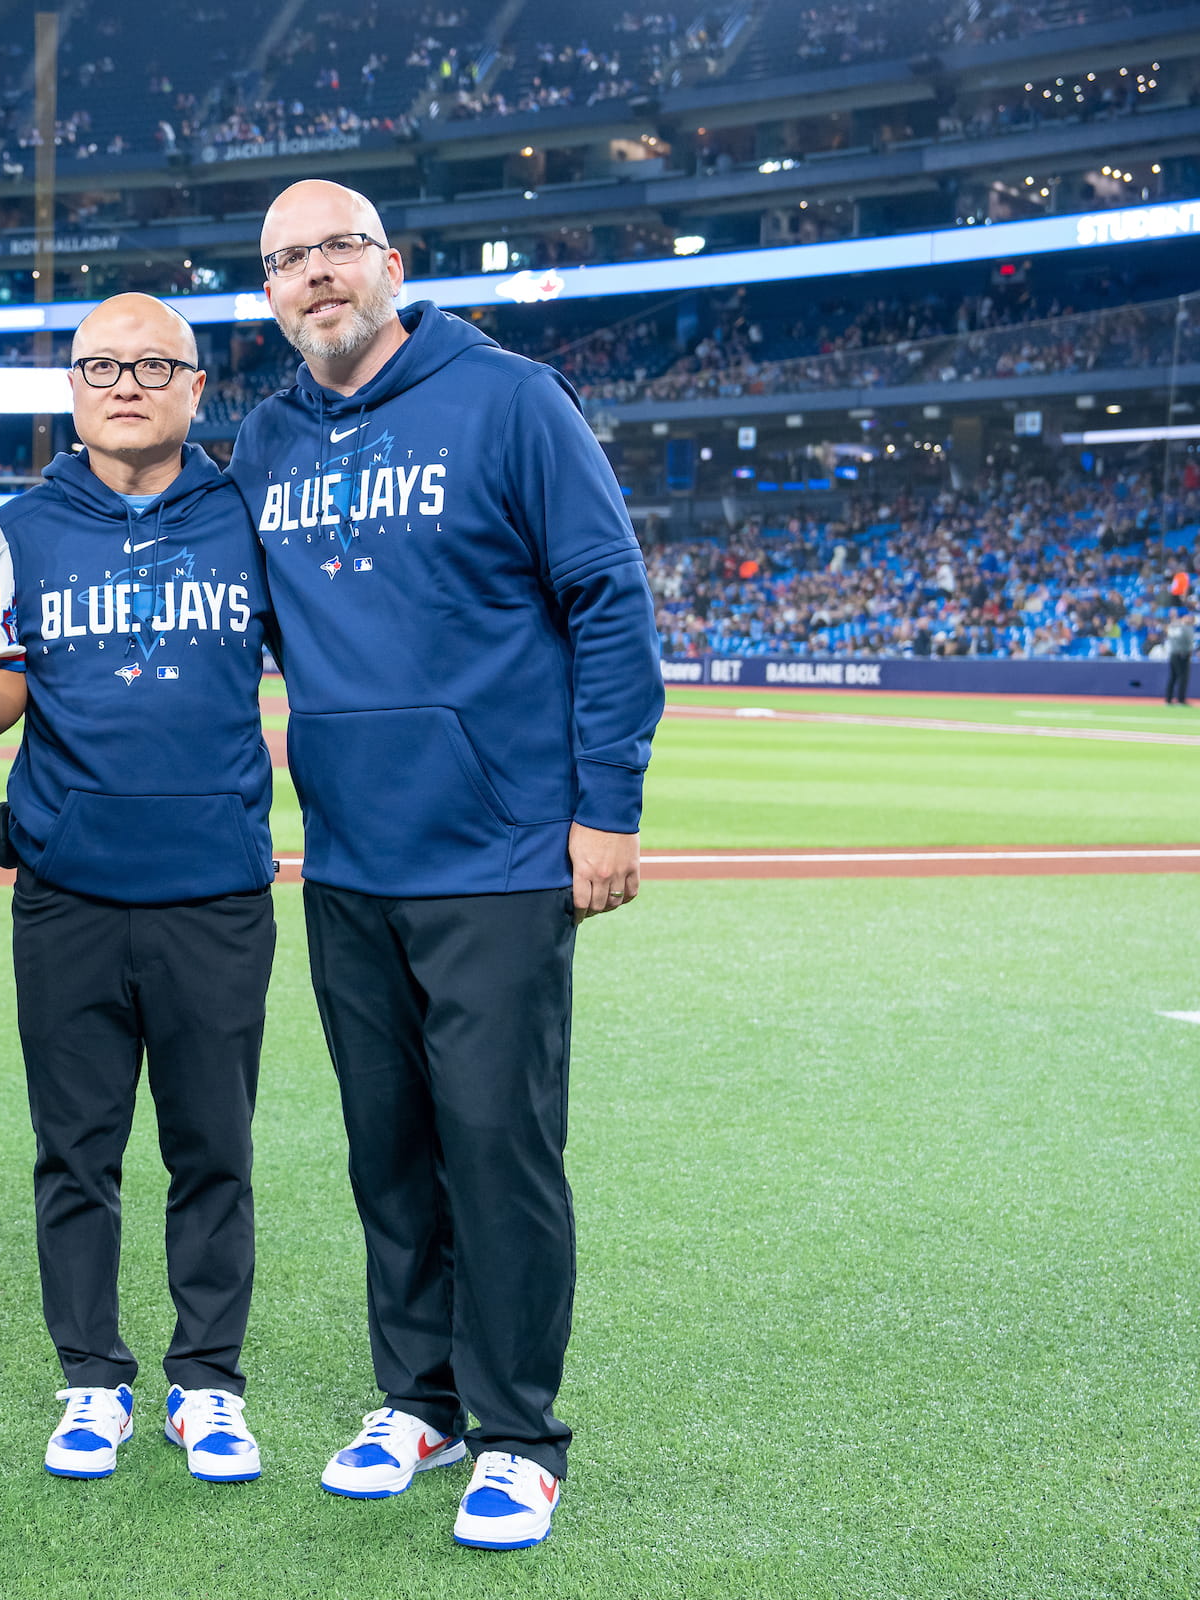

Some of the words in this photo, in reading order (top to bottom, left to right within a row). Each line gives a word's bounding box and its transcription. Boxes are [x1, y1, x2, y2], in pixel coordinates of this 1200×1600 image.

[267, 448, 449, 480] TORONTO
[259, 473, 342, 532] BLUE
[350, 463, 447, 522] JAYS
[39, 568, 249, 588] TORONTO
[41, 583, 141, 641] BLUE
[151, 581, 251, 633] JAYS
[43, 636, 248, 655] BASBALL
[710, 659, 742, 682] BET
[766, 662, 843, 684] BASELINE
[845, 663, 881, 685] BOX
